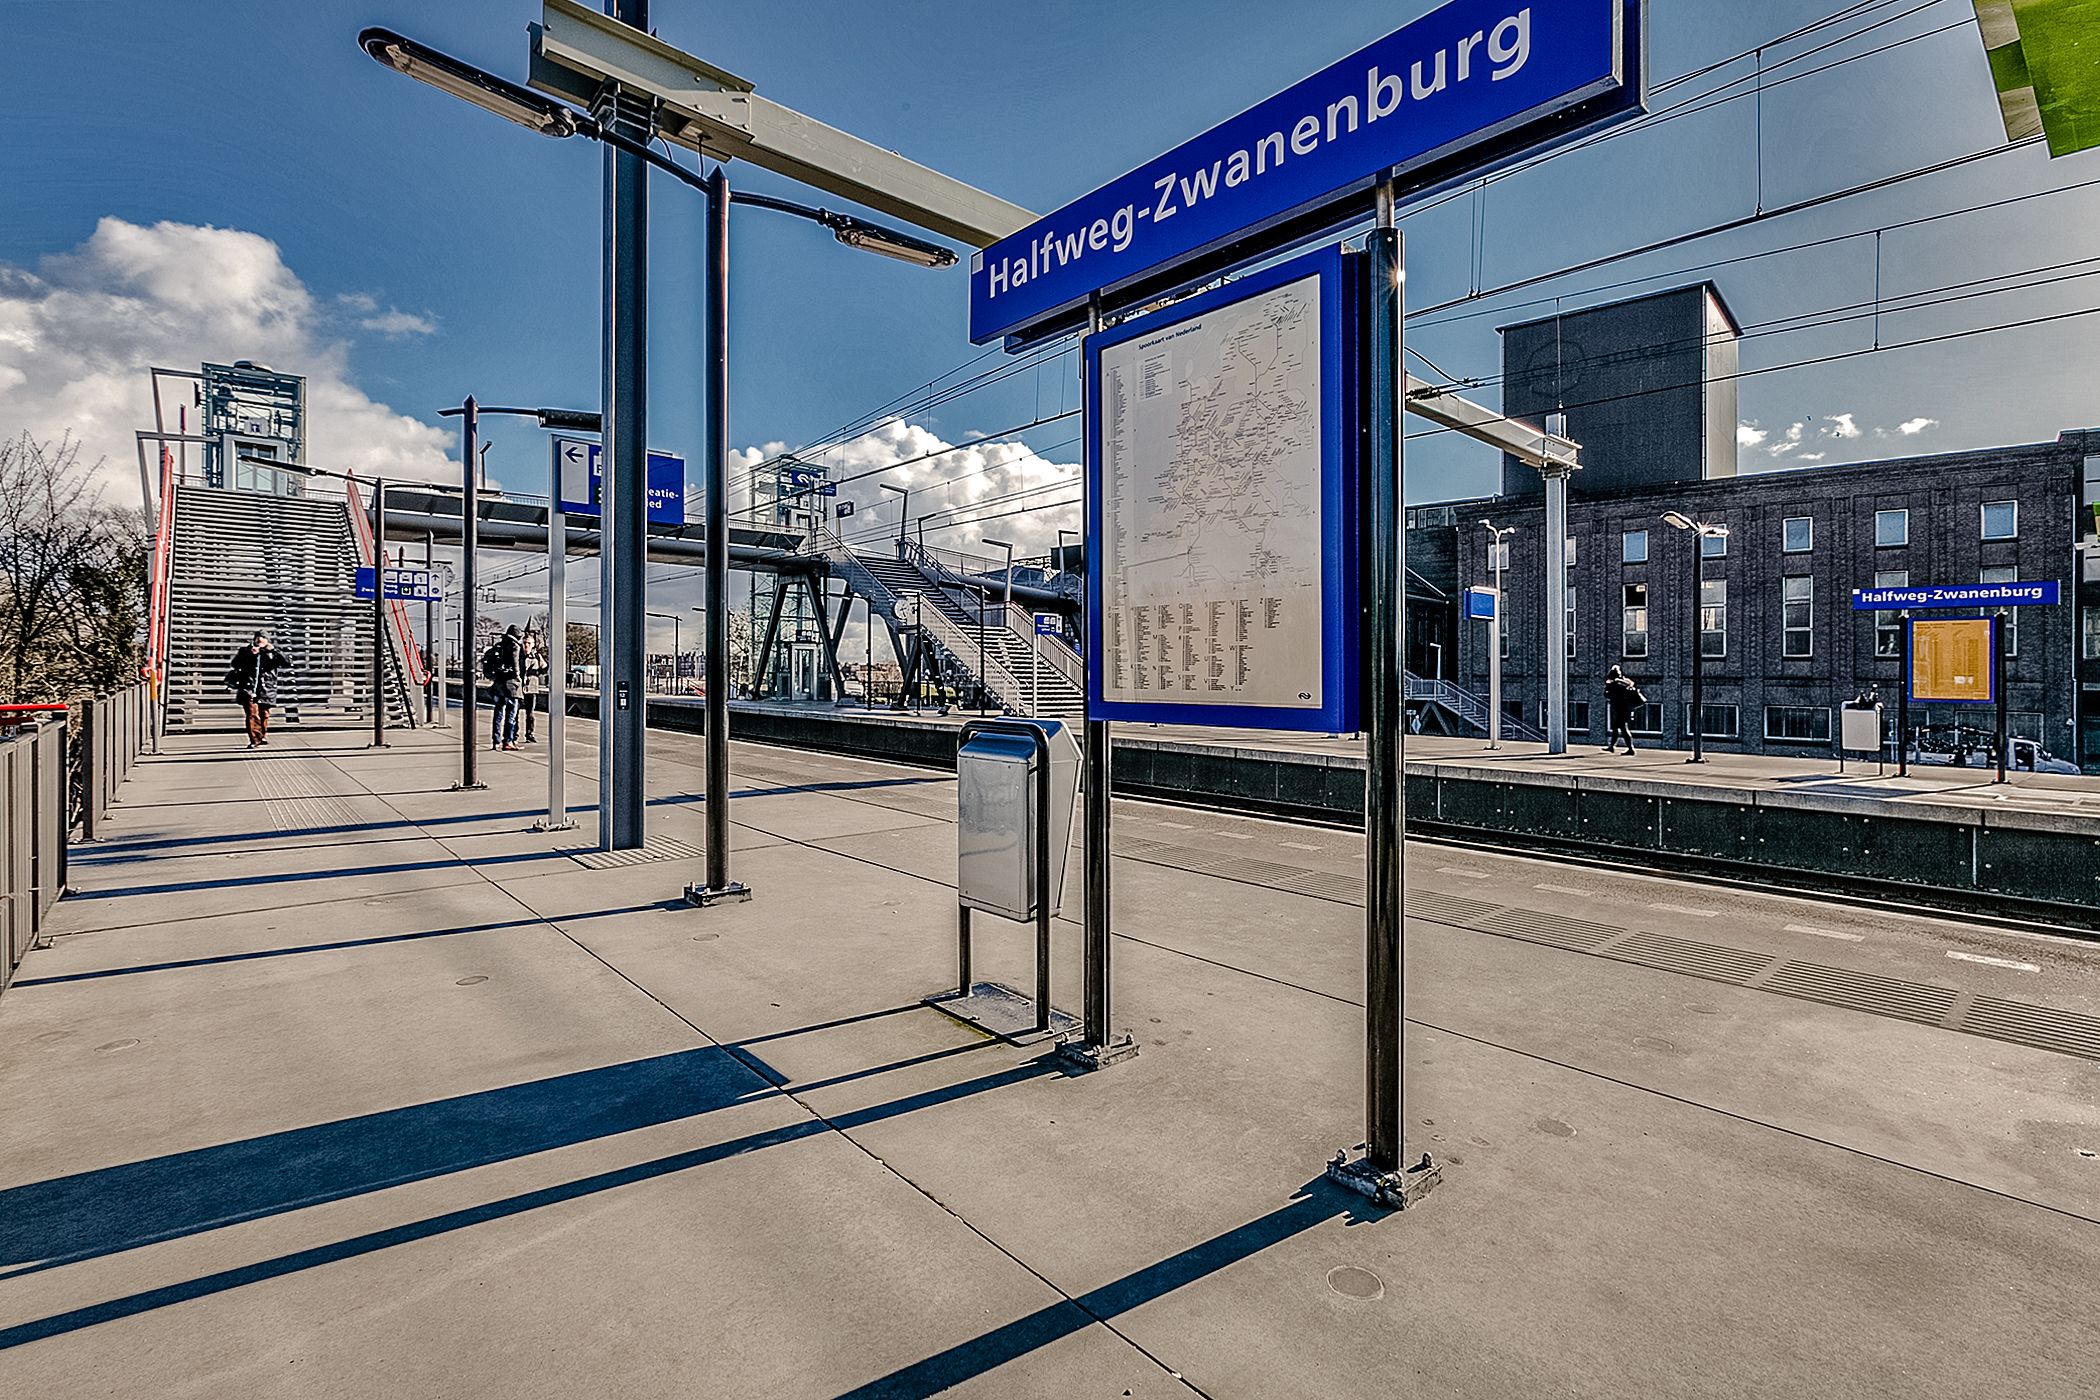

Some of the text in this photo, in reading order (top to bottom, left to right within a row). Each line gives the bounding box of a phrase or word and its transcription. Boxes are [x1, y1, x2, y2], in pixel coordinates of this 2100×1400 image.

[989, 7, 1531, 299] Halfweg-Zwanenburg
[1175, 323, 1202, 338] Nederland
[647, 488, 679, 500] eatie-
[1861, 586, 2043, 604] Halfweg-Zwanenburg
